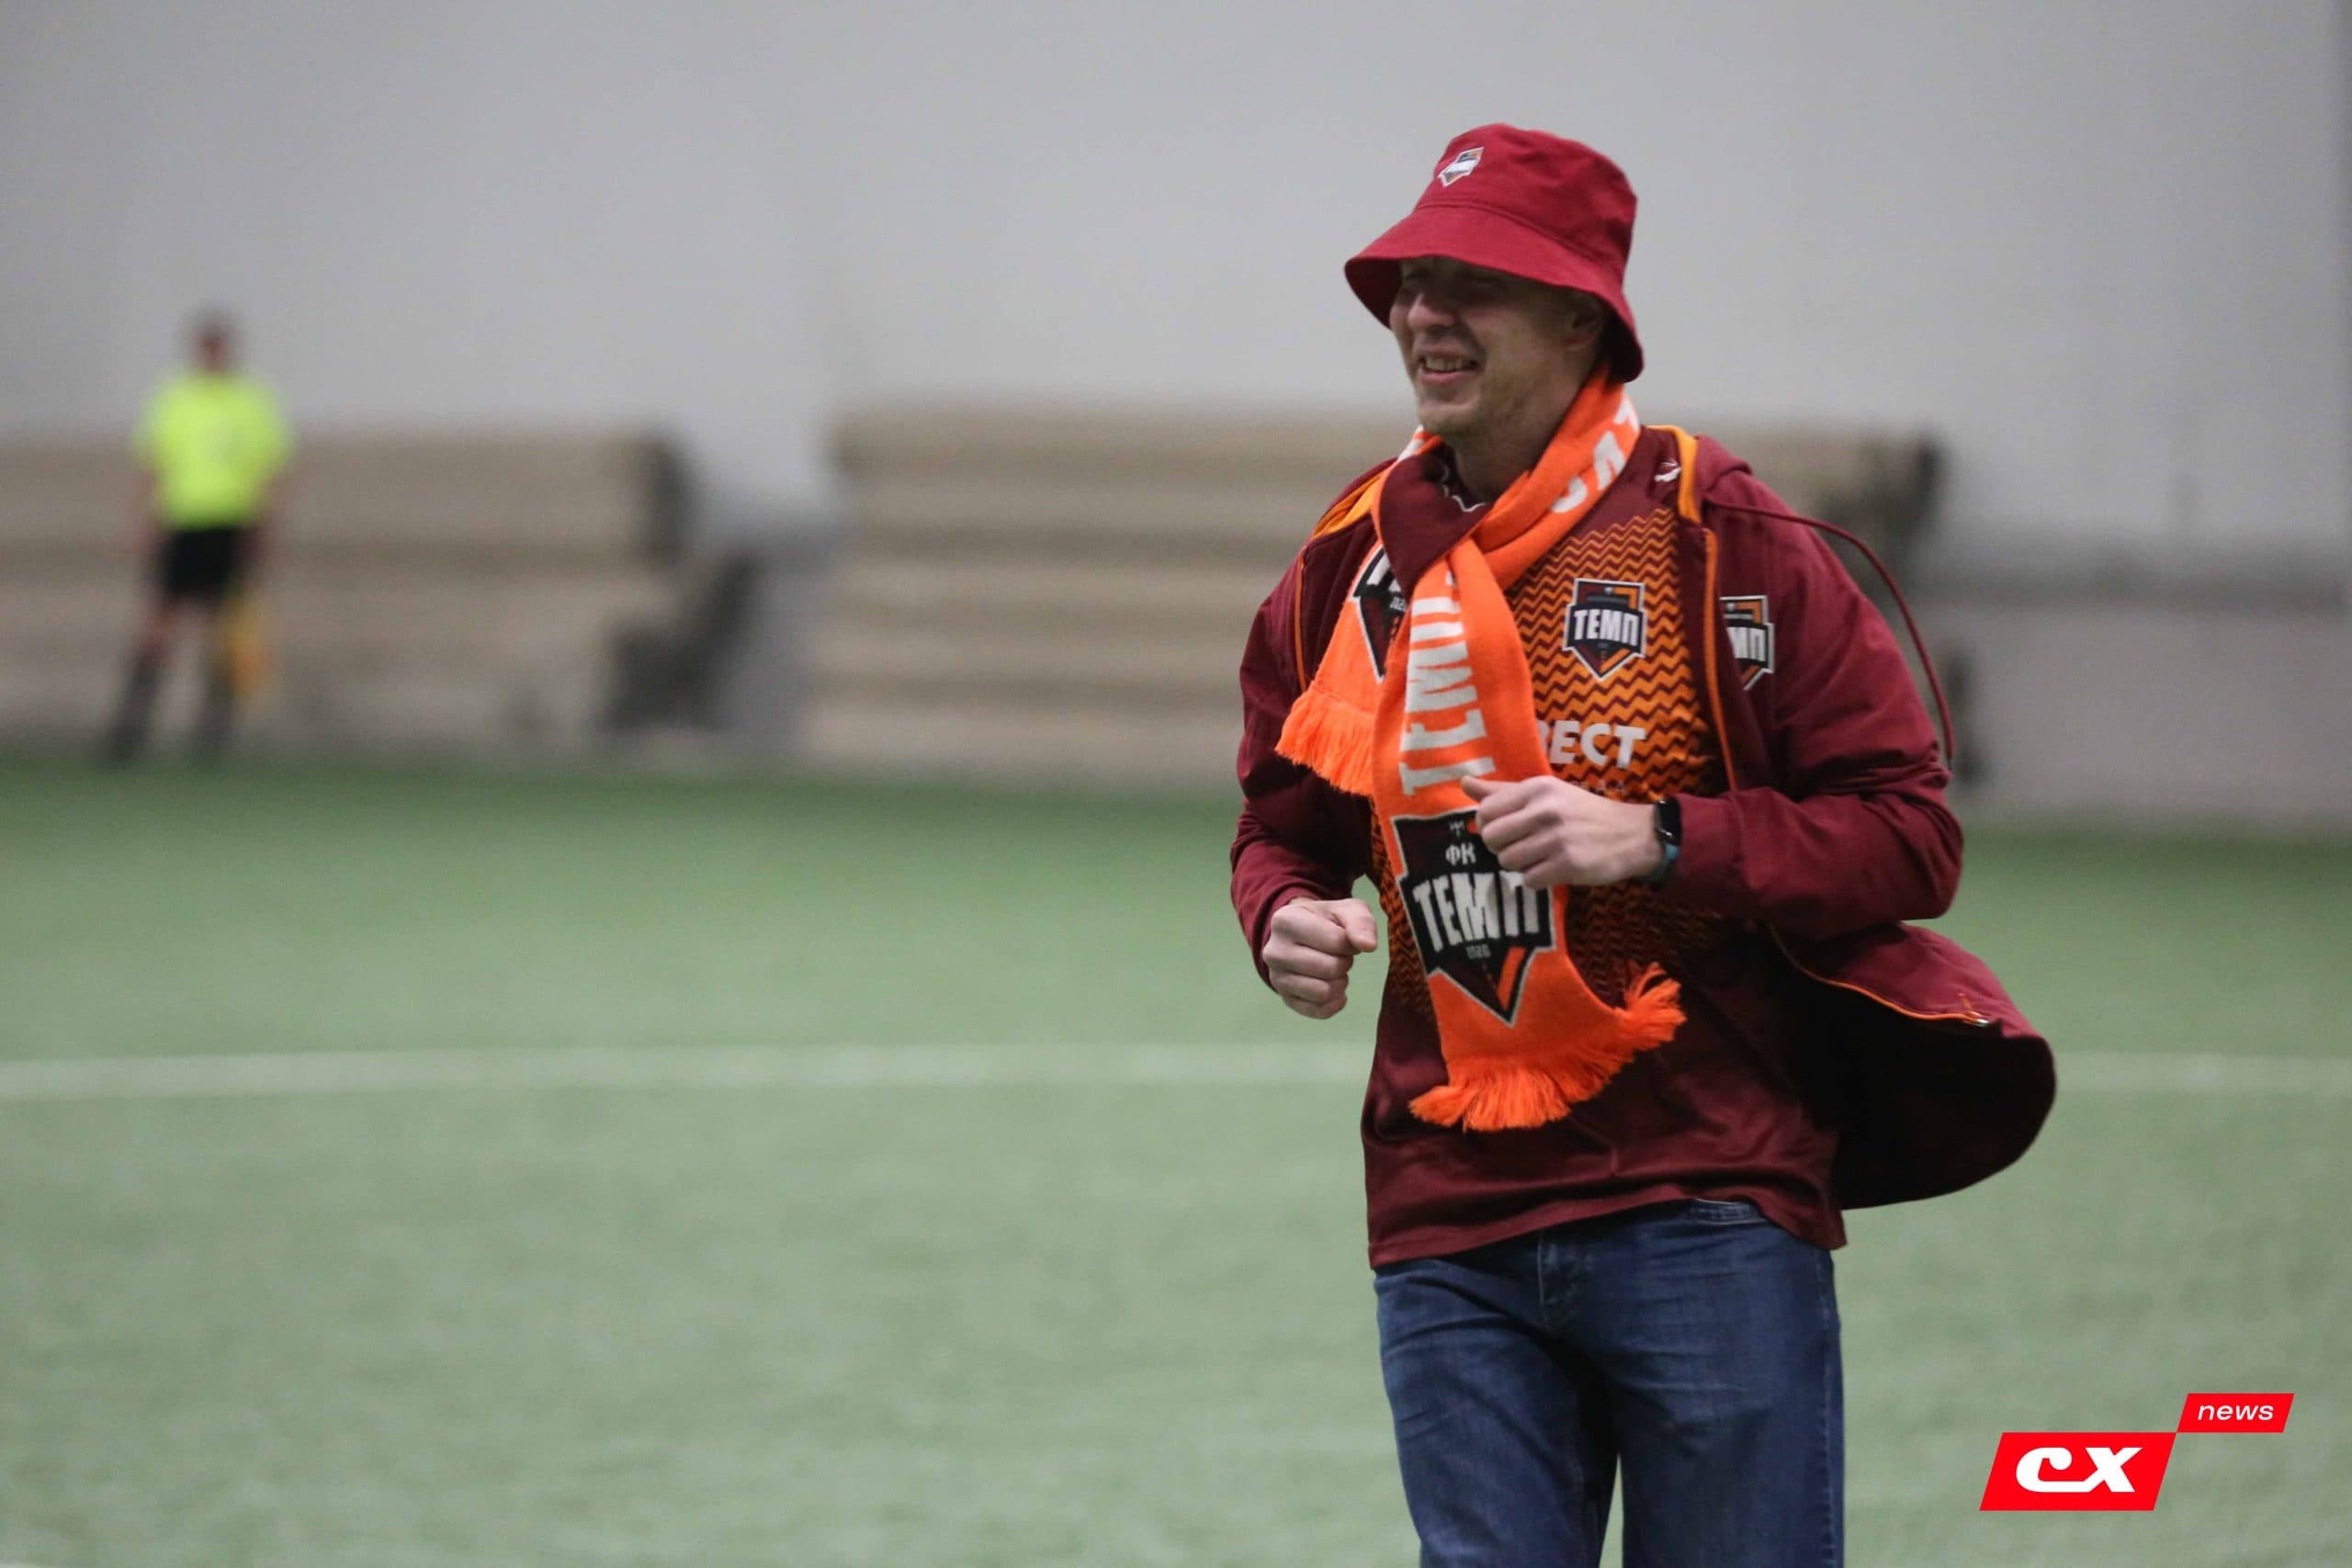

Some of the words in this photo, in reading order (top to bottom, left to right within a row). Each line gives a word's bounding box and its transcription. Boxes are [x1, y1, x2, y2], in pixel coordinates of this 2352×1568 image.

[1573, 608, 1639, 647] ТЕМП
[1726, 626, 1766, 661] МП
[1445, 842, 1476, 865] ФК
[1412, 871, 1540, 953] ТЕМП
